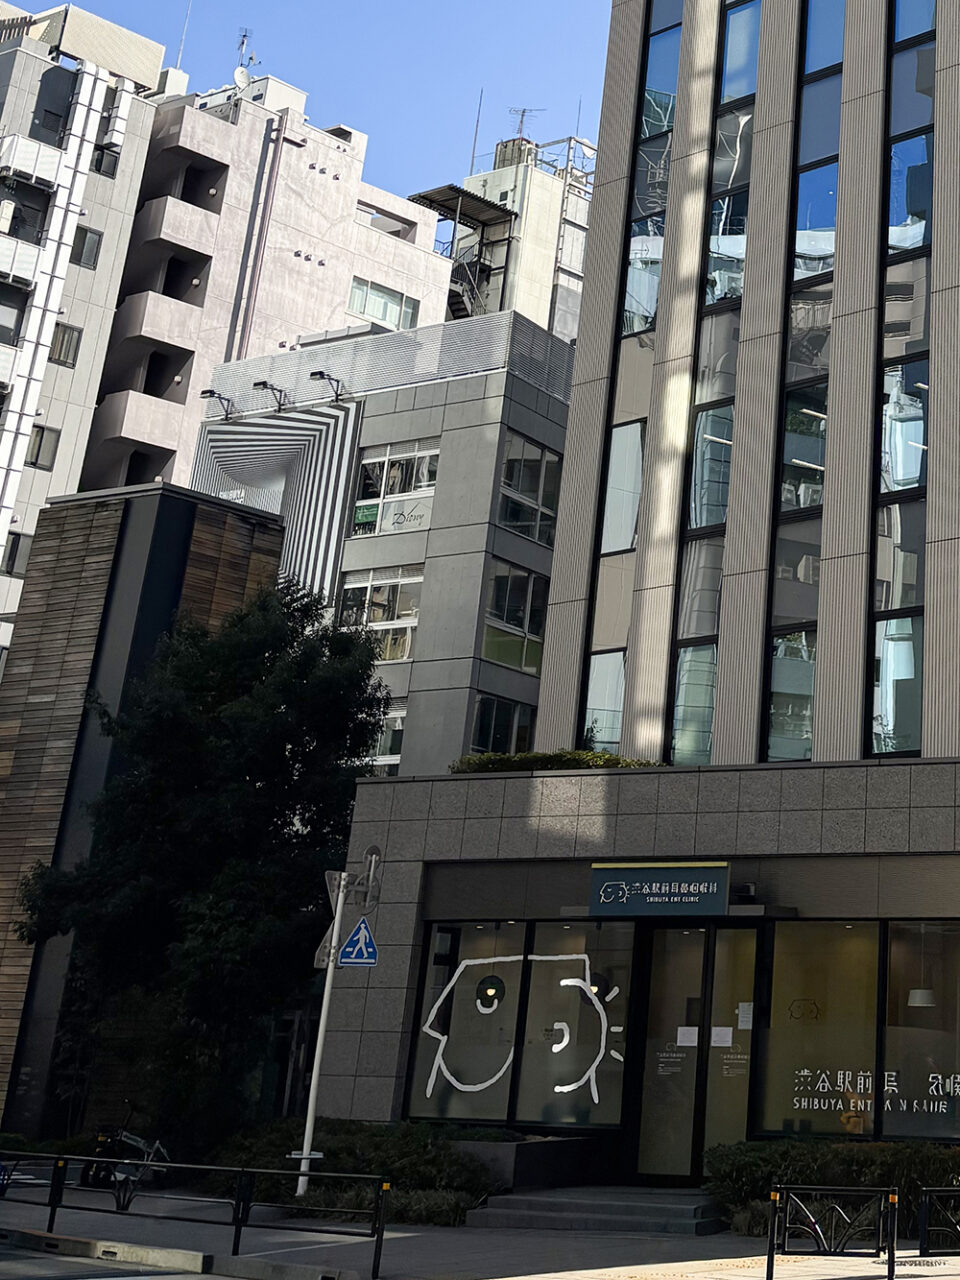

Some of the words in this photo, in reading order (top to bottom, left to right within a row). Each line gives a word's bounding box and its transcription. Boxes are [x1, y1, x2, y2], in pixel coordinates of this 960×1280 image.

[794, 1068, 872, 1094] 渋谷駅前
[793, 1097, 844, 1111] SHIBUYA
[850, 1099, 872, 1111] ENT
